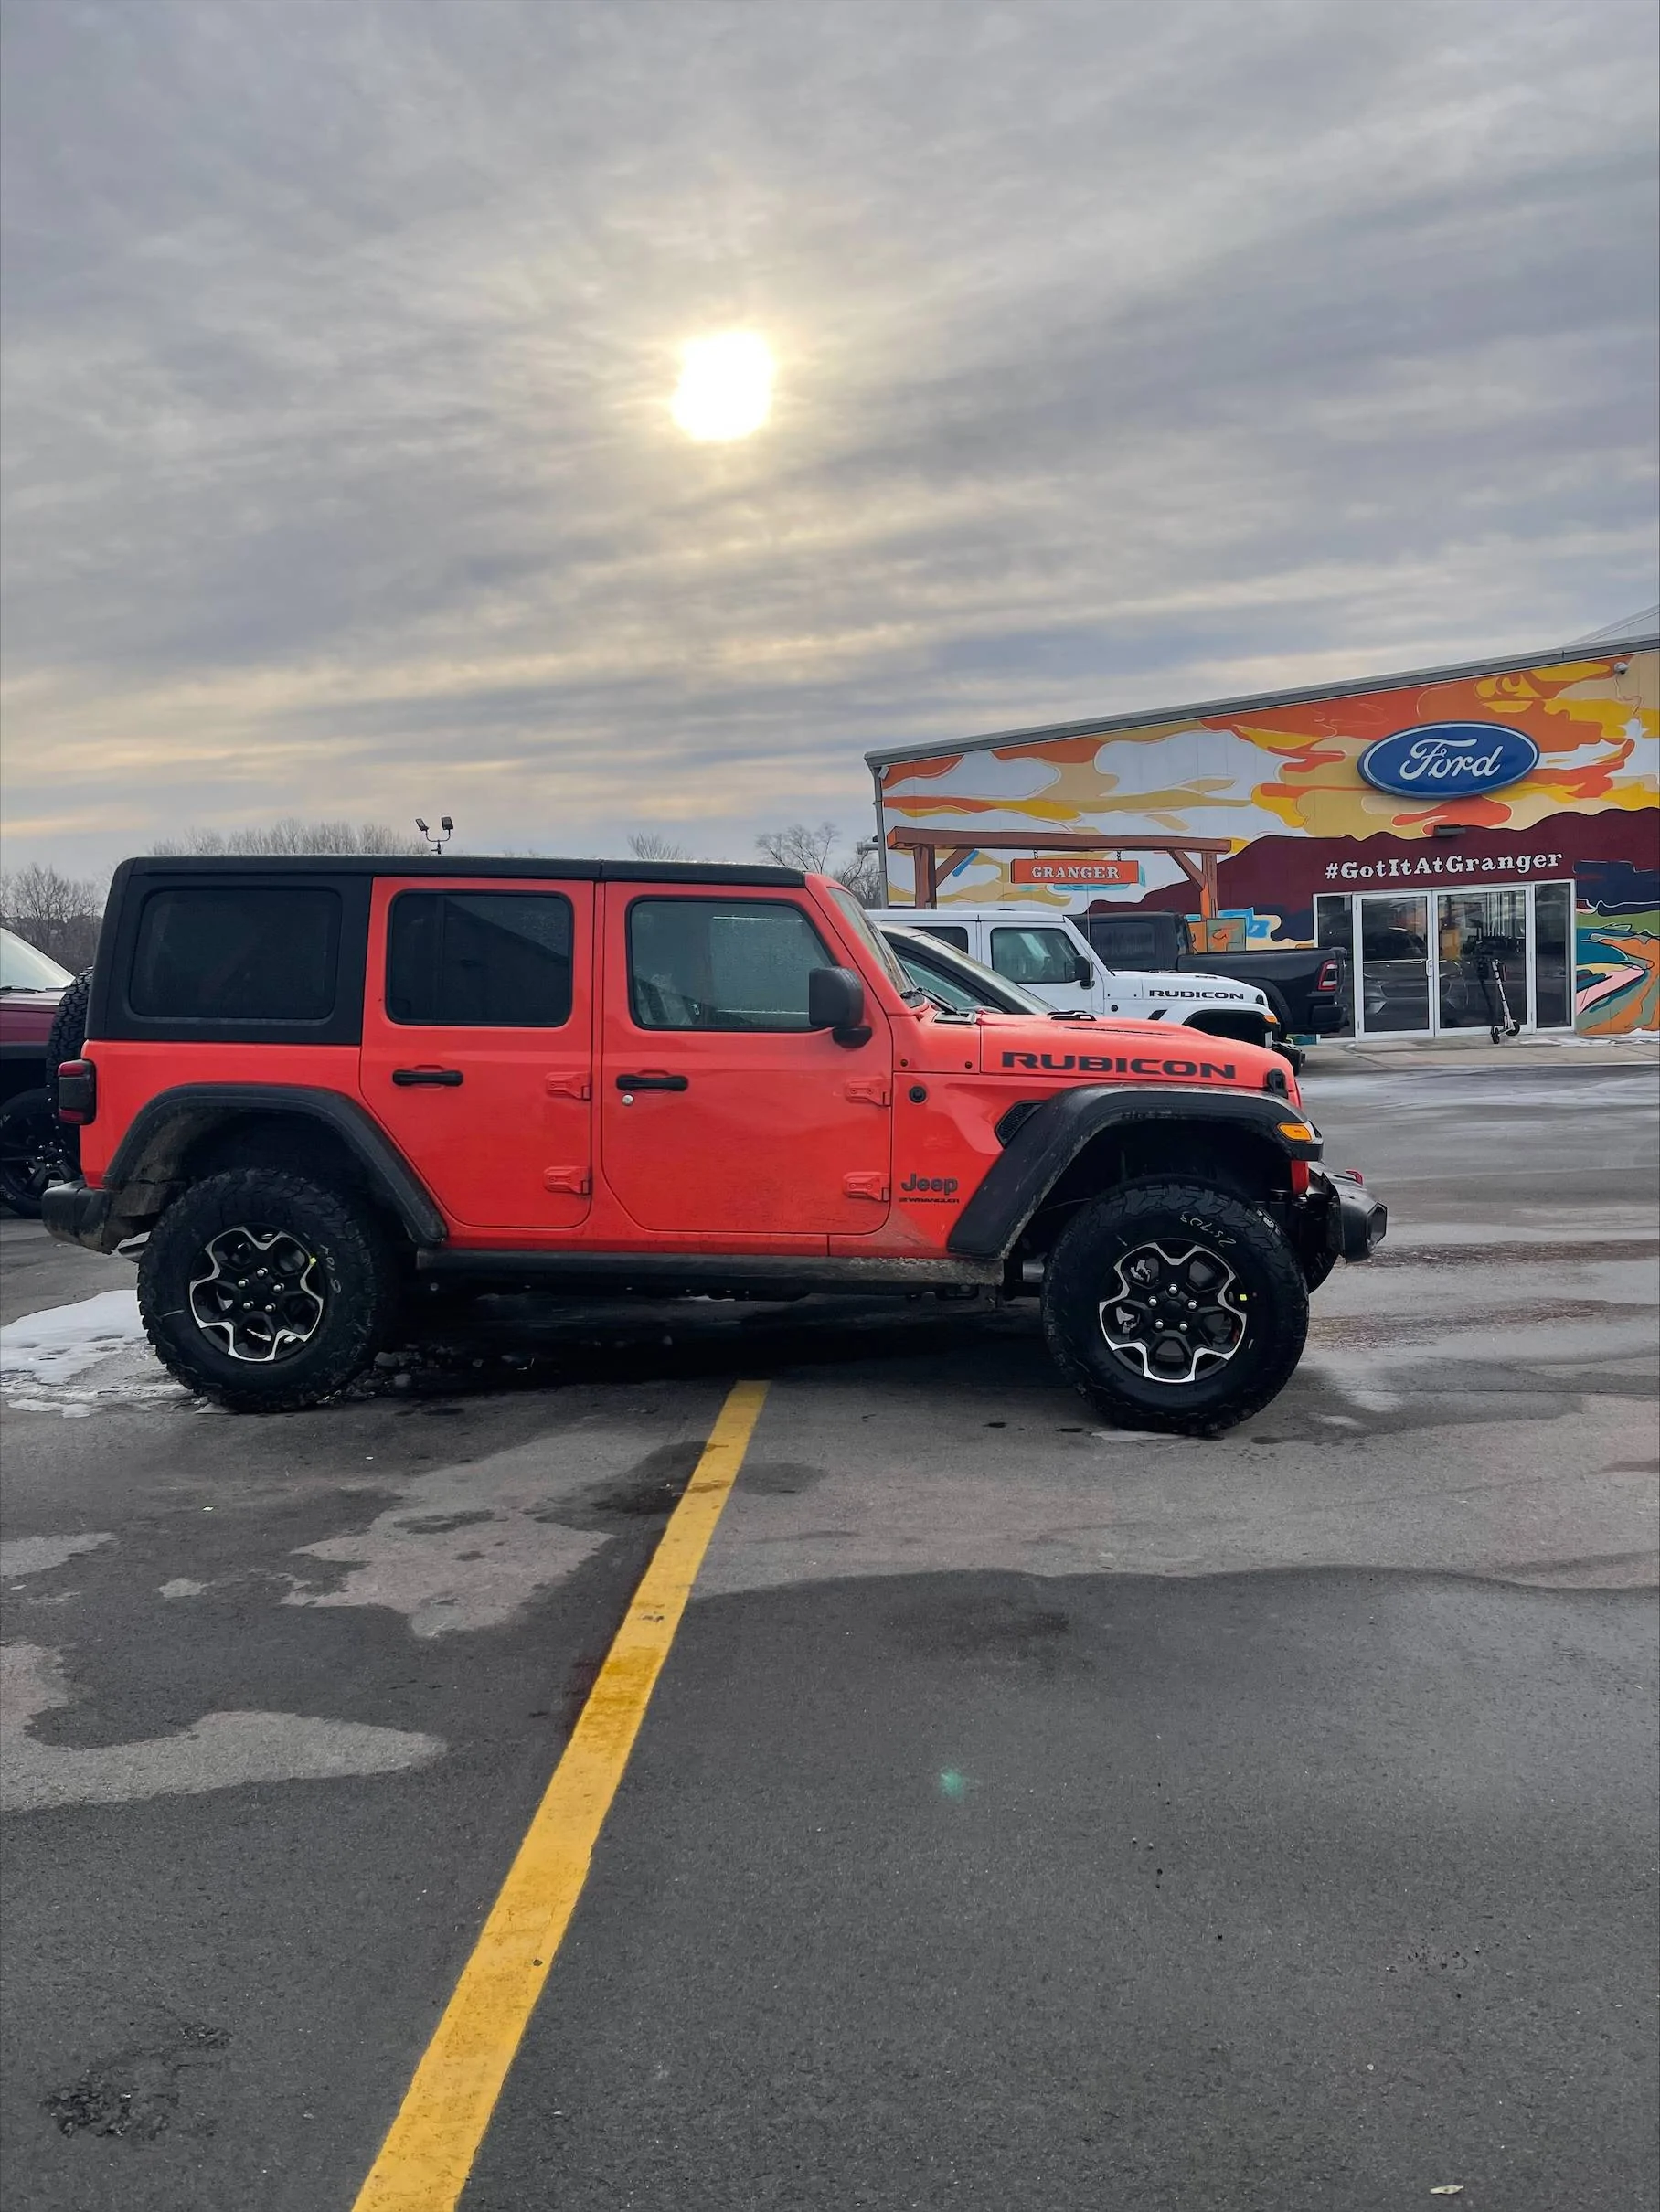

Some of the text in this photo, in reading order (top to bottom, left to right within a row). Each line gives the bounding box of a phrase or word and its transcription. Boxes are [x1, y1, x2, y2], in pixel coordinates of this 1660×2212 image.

[1399, 738, 1504, 781] Ford
[1031, 867, 1121, 879] GRANGER
[1325, 853, 1562, 880] #GotItAtGranger
[1149, 989, 1244, 1000] RUBICON
[1002, 1051, 1236, 1079] RUBICON
[900, 1173, 958, 1196] Jeep
